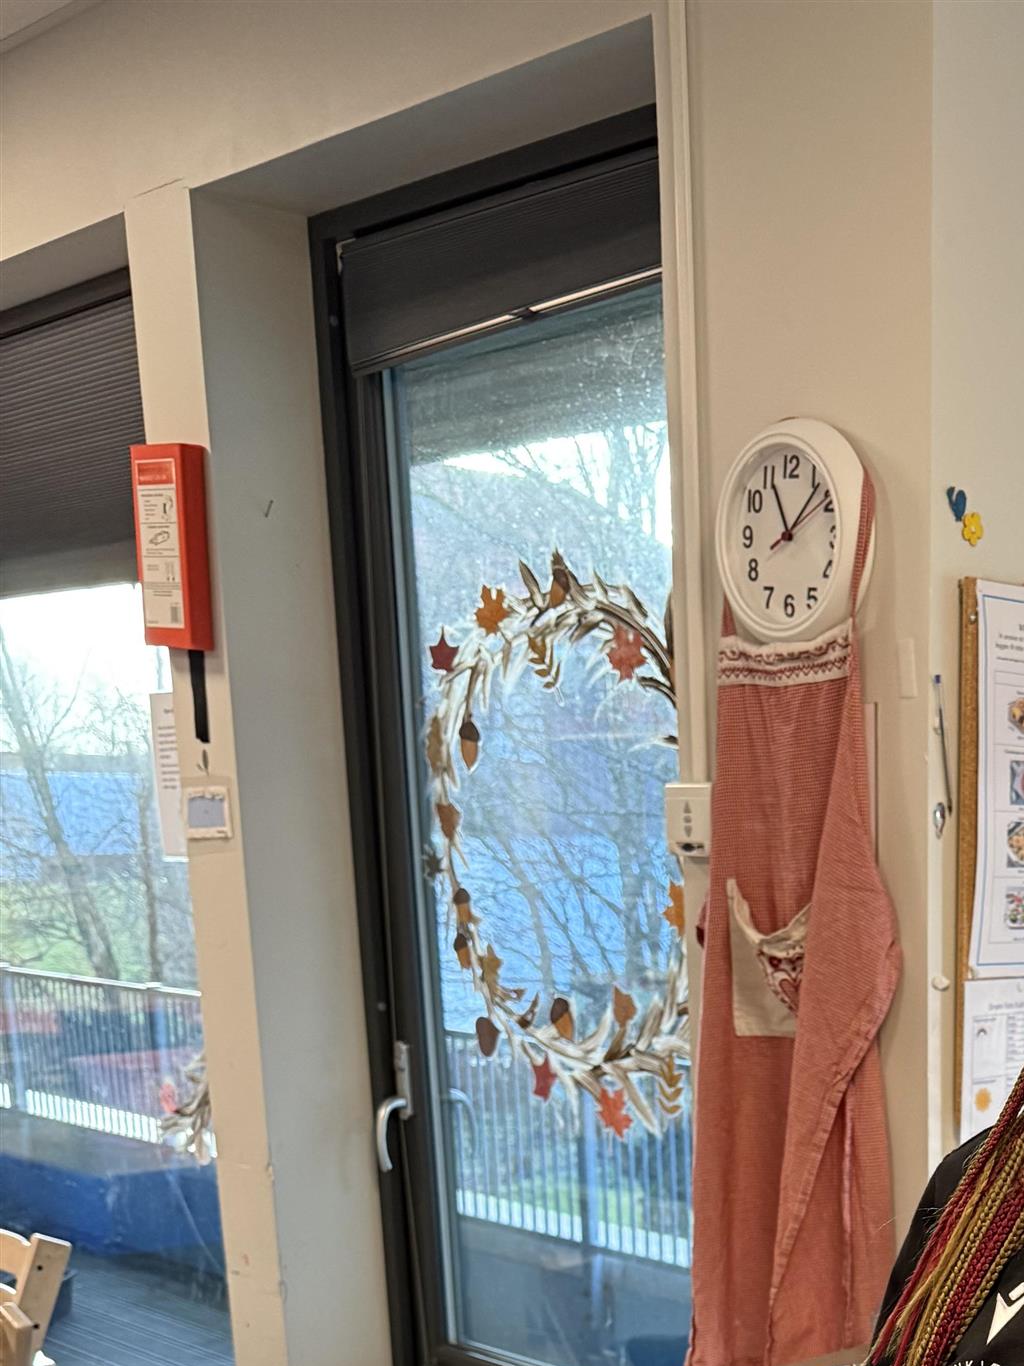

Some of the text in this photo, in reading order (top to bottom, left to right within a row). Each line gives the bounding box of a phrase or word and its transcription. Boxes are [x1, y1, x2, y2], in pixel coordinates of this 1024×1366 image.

[763, 465, 776, 490] 11
[783, 454, 800, 479] 12
[811, 464, 817, 489] 1
[747, 489, 763, 514] 10
[742, 525, 754, 549] 9
[748, 558, 759, 581] 8
[763, 586, 775, 610] 7
[783, 594, 795, 618] 6
[807, 587, 818, 610] 5
